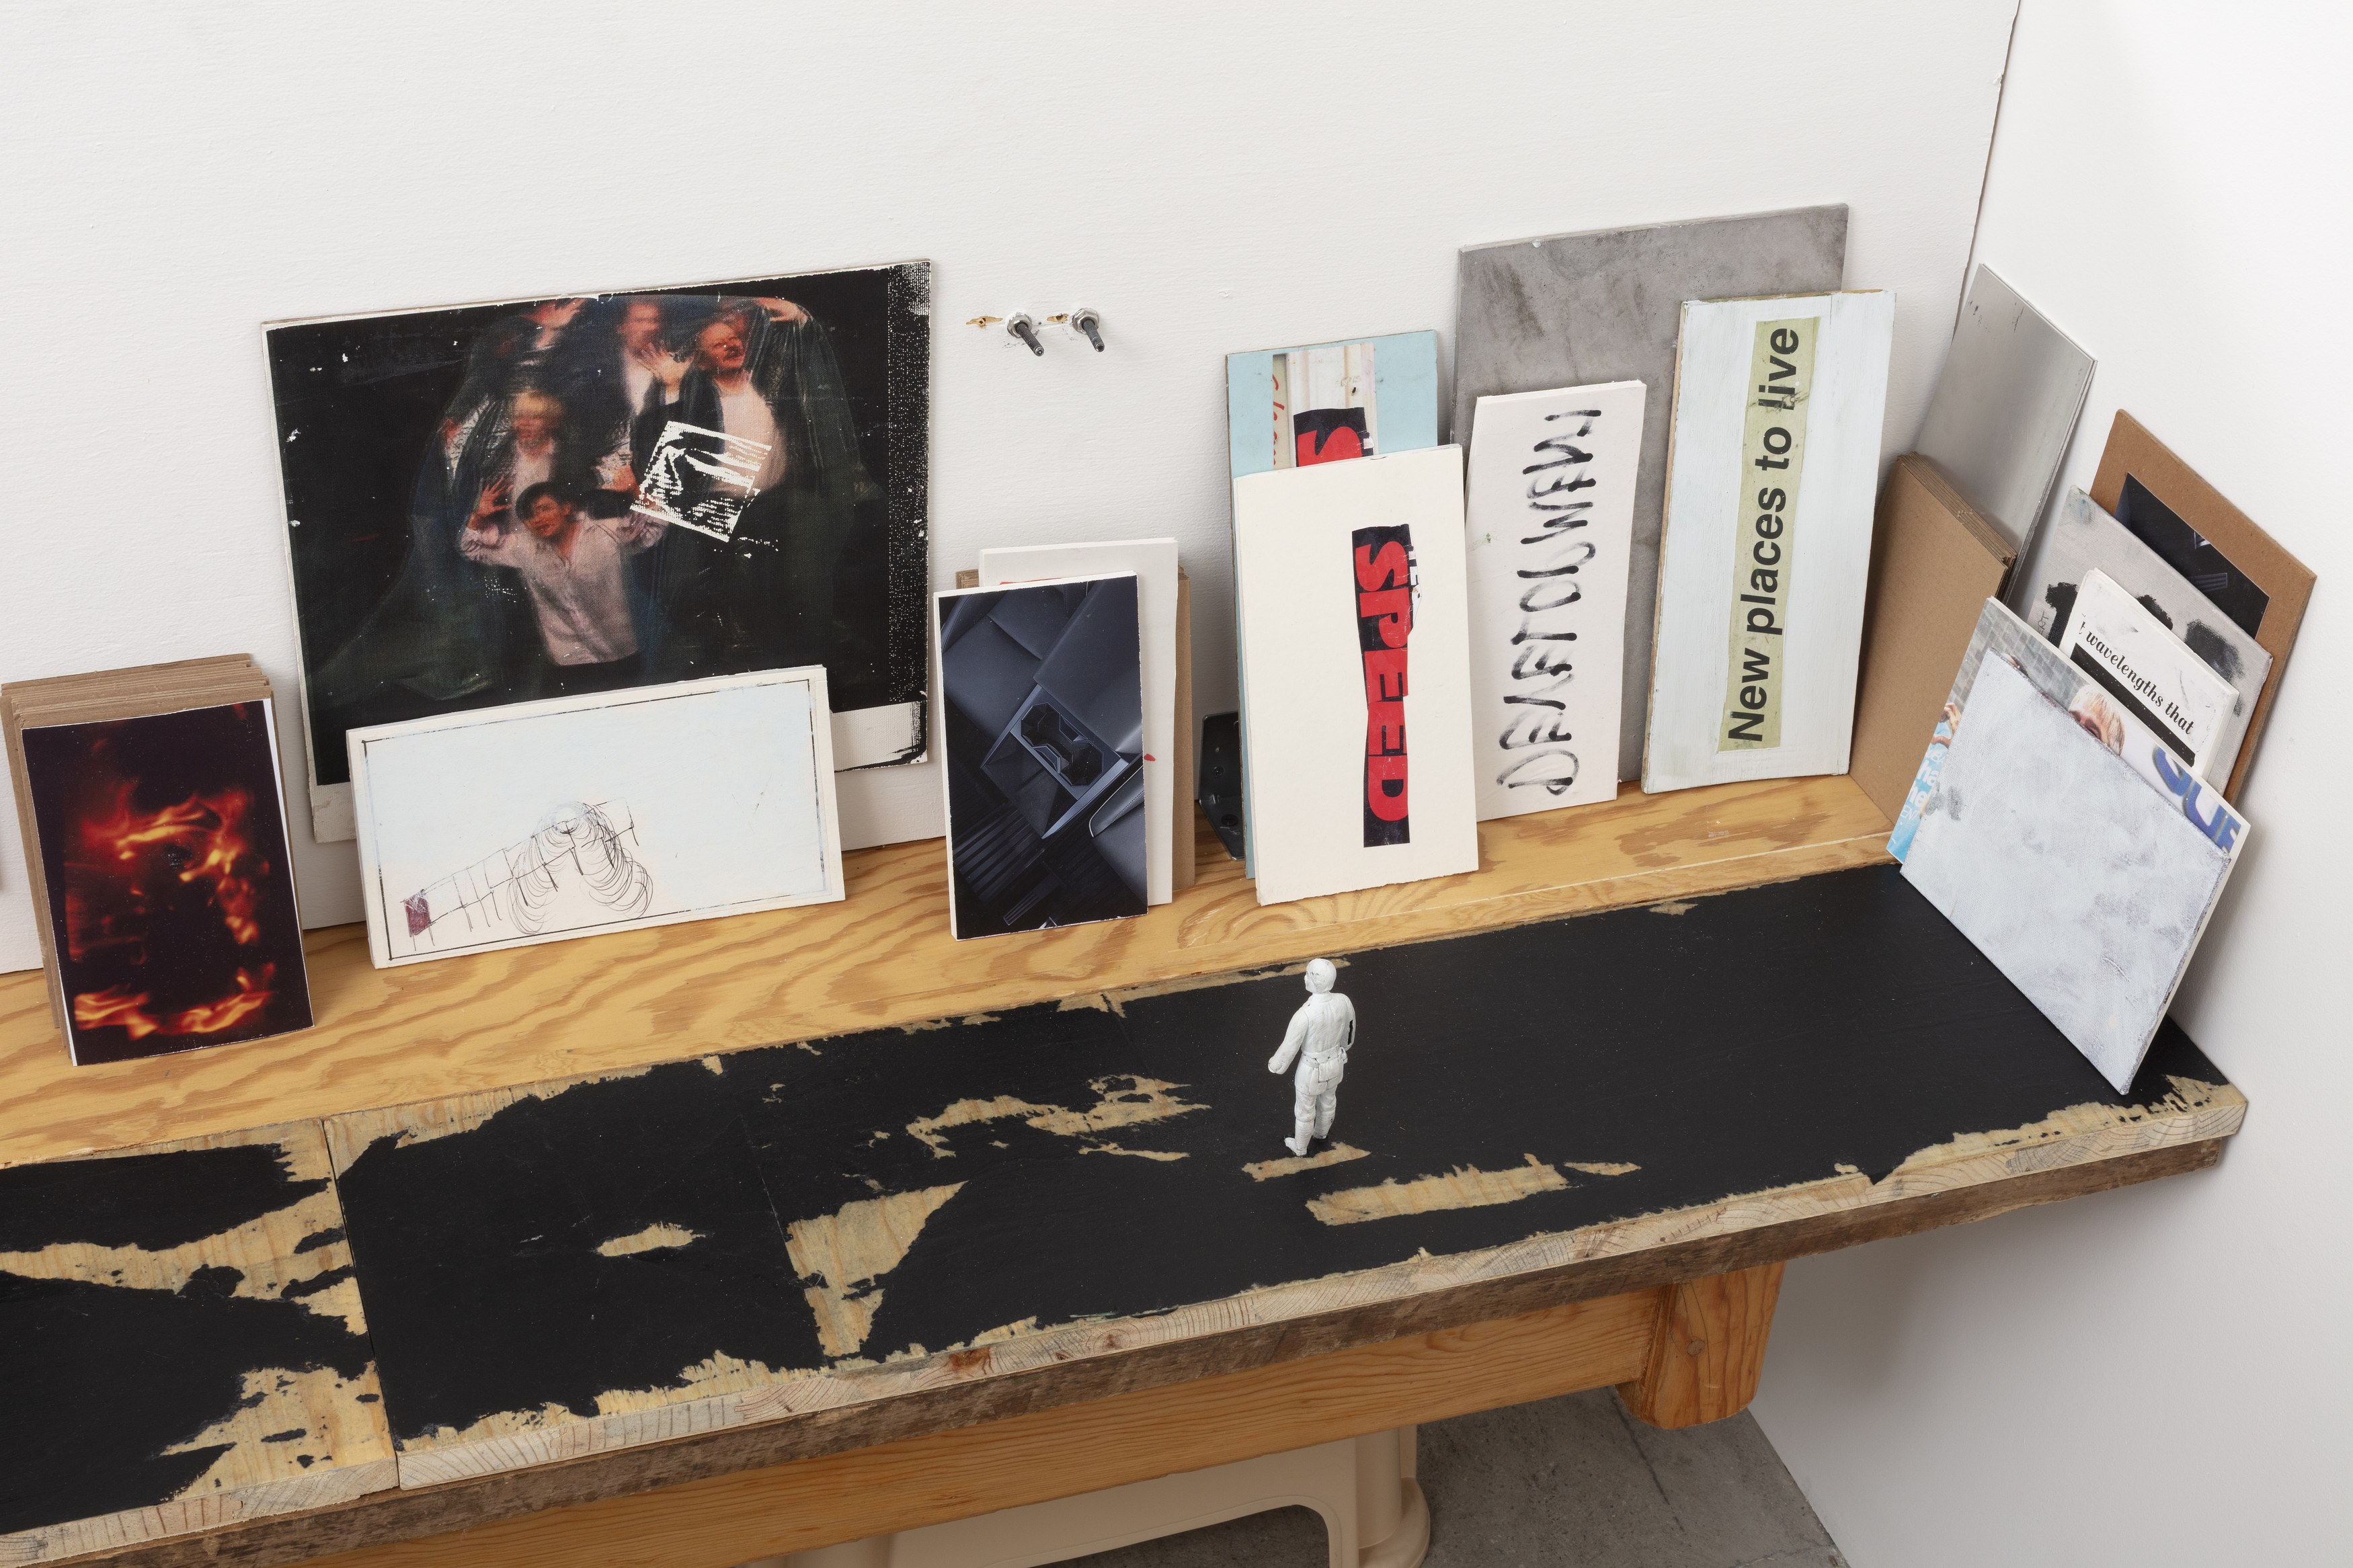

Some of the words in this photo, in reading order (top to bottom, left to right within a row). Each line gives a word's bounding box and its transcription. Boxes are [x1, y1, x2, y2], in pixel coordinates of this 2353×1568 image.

[1758, 328, 1799, 410] live
[1755, 427, 1792, 471] to
[1741, 487, 1786, 635] places
[1355, 540, 1409, 821] SPEED
[1728, 648, 1771, 741] New
[2085, 630, 2164, 707] wavelengths
[2165, 702, 2195, 735] that
